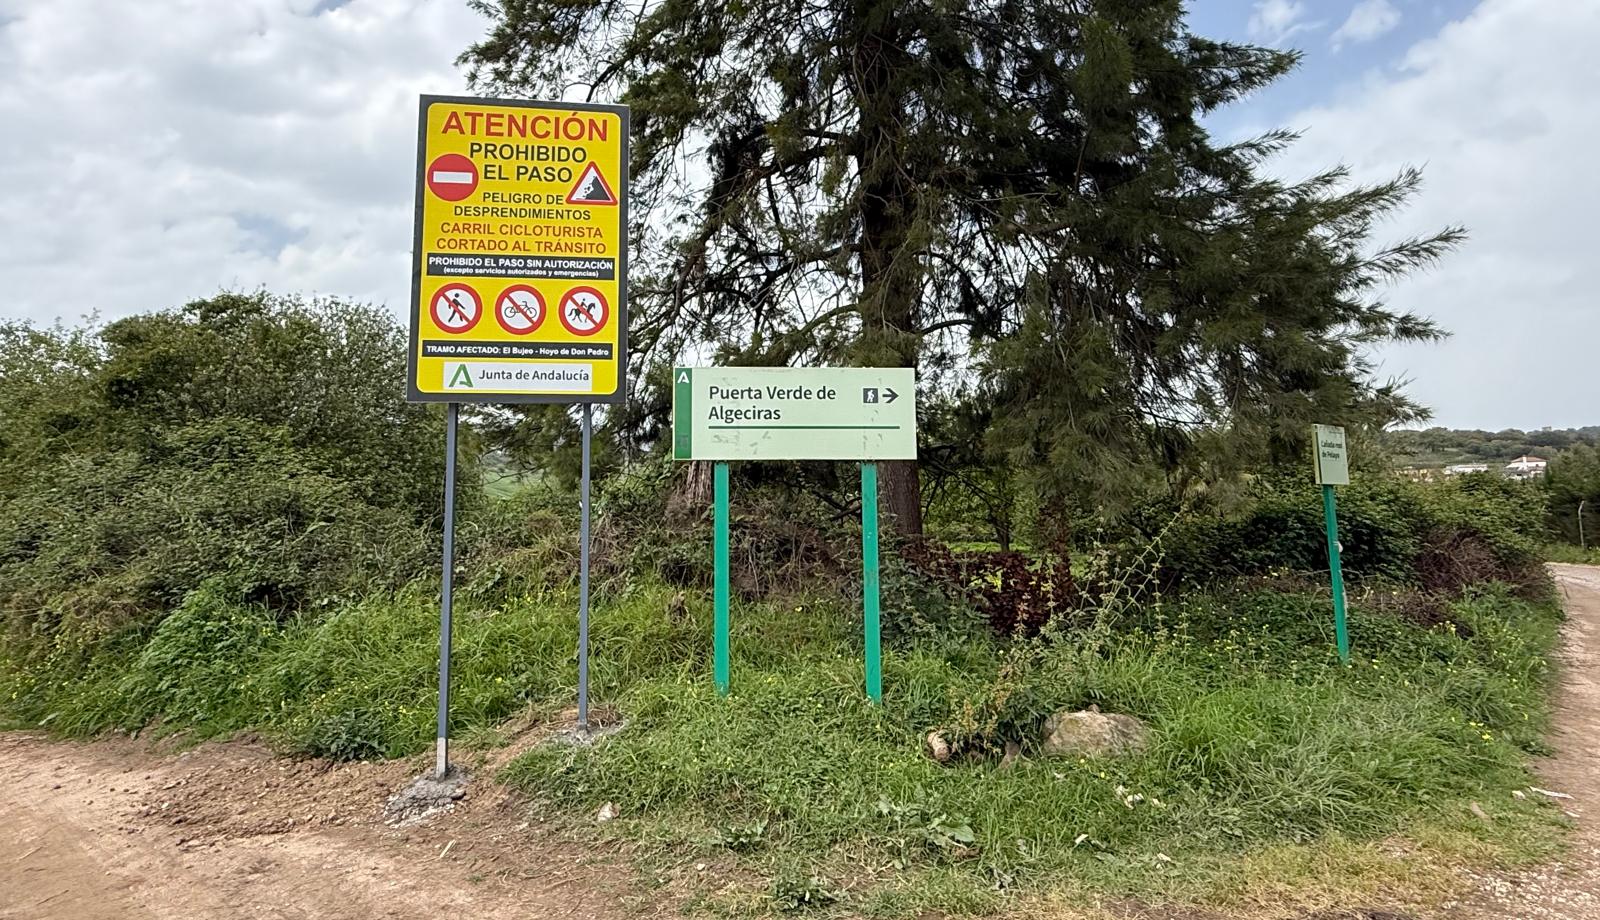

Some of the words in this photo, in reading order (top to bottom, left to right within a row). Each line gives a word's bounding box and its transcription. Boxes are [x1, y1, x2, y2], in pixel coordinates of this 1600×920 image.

[442, 111, 608, 142] ATENCIÓN
[470, 142, 587, 163] PROHIBIDO
[484, 164, 509, 181] EL
[516, 165, 573, 183] PASO
[483, 192, 542, 205] PELIGRO
[547, 194, 564, 205] DE
[454, 205, 591, 220] DESPRENDIMIENTOS
[441, 222, 495, 235] CARRIL
[500, 224, 603, 239] CICLOTURISTA
[437, 238, 508, 252] CORTADO
[512, 239, 530, 252] AL
[535, 240, 606, 254] TRÁNSITO
[429, 256, 482, 266] PROHIBIDO
[484, 258, 497, 267] EL
[499, 258, 524, 268] PASO
[527, 259, 542, 268] SIN
[544, 259, 613, 270] AUTORIZACIÓN
[443, 266, 474, 275] (excepto
[475, 267, 506, 275] servicios
[507, 268, 547, 276] autorizados
[548, 269, 553, 277] y
[554, 270, 599, 278] emergencias)
[426, 345, 456, 353] TRAMO
[456, 346, 501, 354] AFECTADO:
[512, 347, 534, 356] Bujeo
[539, 348, 559, 356] Hoyo
[570, 348, 586, 356] Don
[587, 348, 609, 356] Pedro
[479, 369, 512, 380] Junta
[515, 369, 530, 380] de
[532, 369, 589, 381] Andalucía
[709, 386, 762, 400] Puerta
[766, 386, 812, 400] Verde
[816, 386, 836, 400] de
[708, 405, 781, 424] Algeciras
